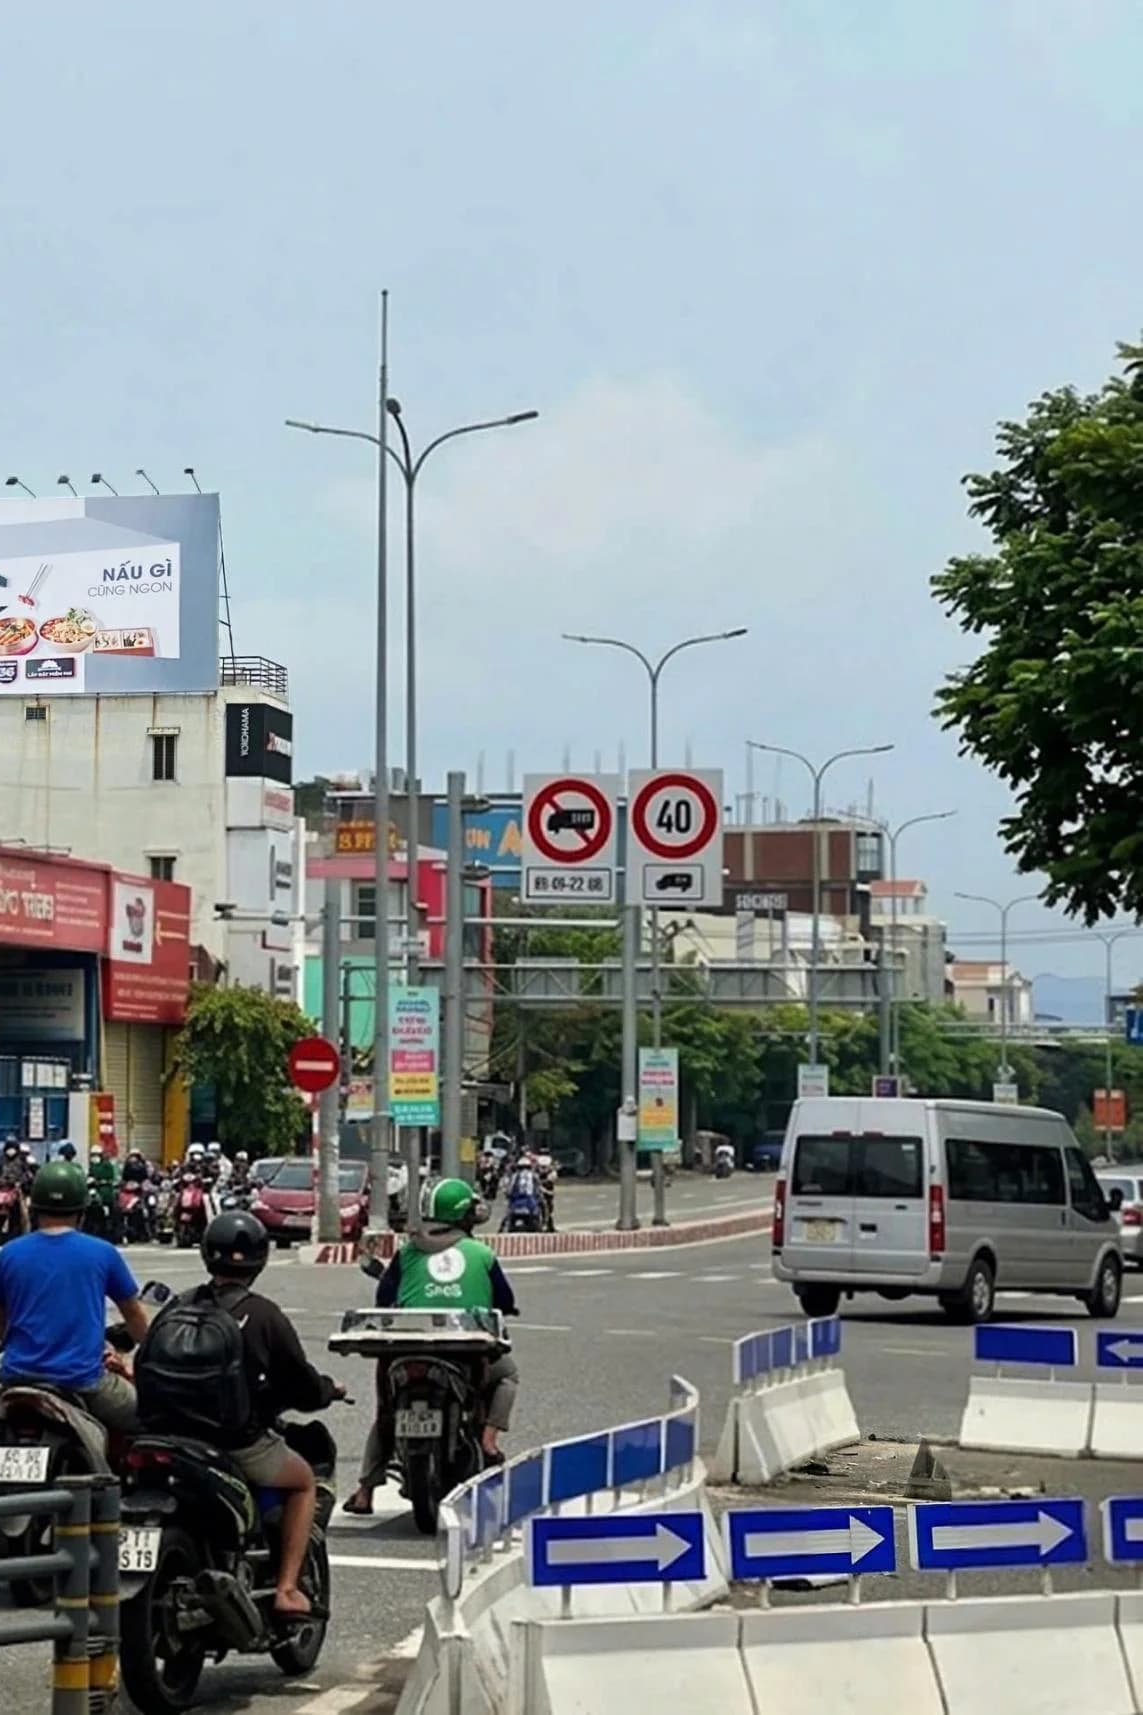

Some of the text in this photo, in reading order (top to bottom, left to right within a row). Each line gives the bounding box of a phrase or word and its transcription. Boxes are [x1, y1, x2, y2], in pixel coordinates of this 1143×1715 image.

[103, 558, 172, 581] NẤU GÌ
[129, 582, 173, 595] NGON
[656, 800, 692, 834] 40
